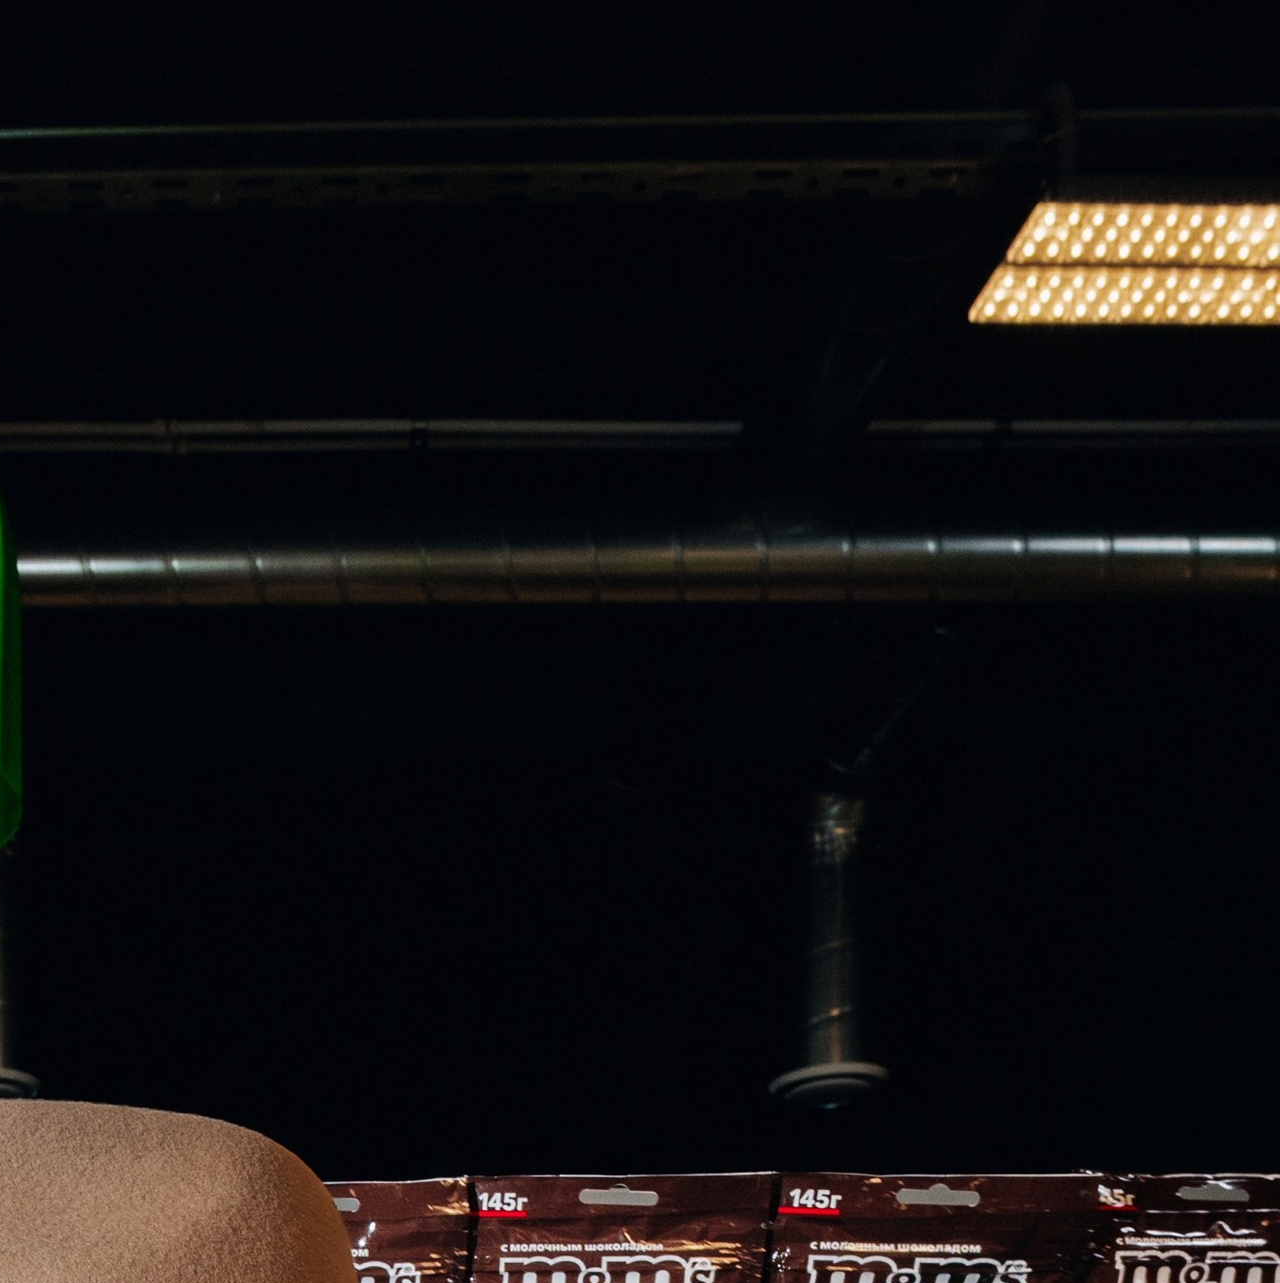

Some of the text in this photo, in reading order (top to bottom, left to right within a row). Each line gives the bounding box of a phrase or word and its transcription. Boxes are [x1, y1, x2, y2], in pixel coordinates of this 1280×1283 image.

[480, 1192, 528, 1211] 145г
[789, 1188, 842, 1209] 145г
[510, 1243, 582, 1252] молочным
[584, 1242, 664, 1252] шоколадом
